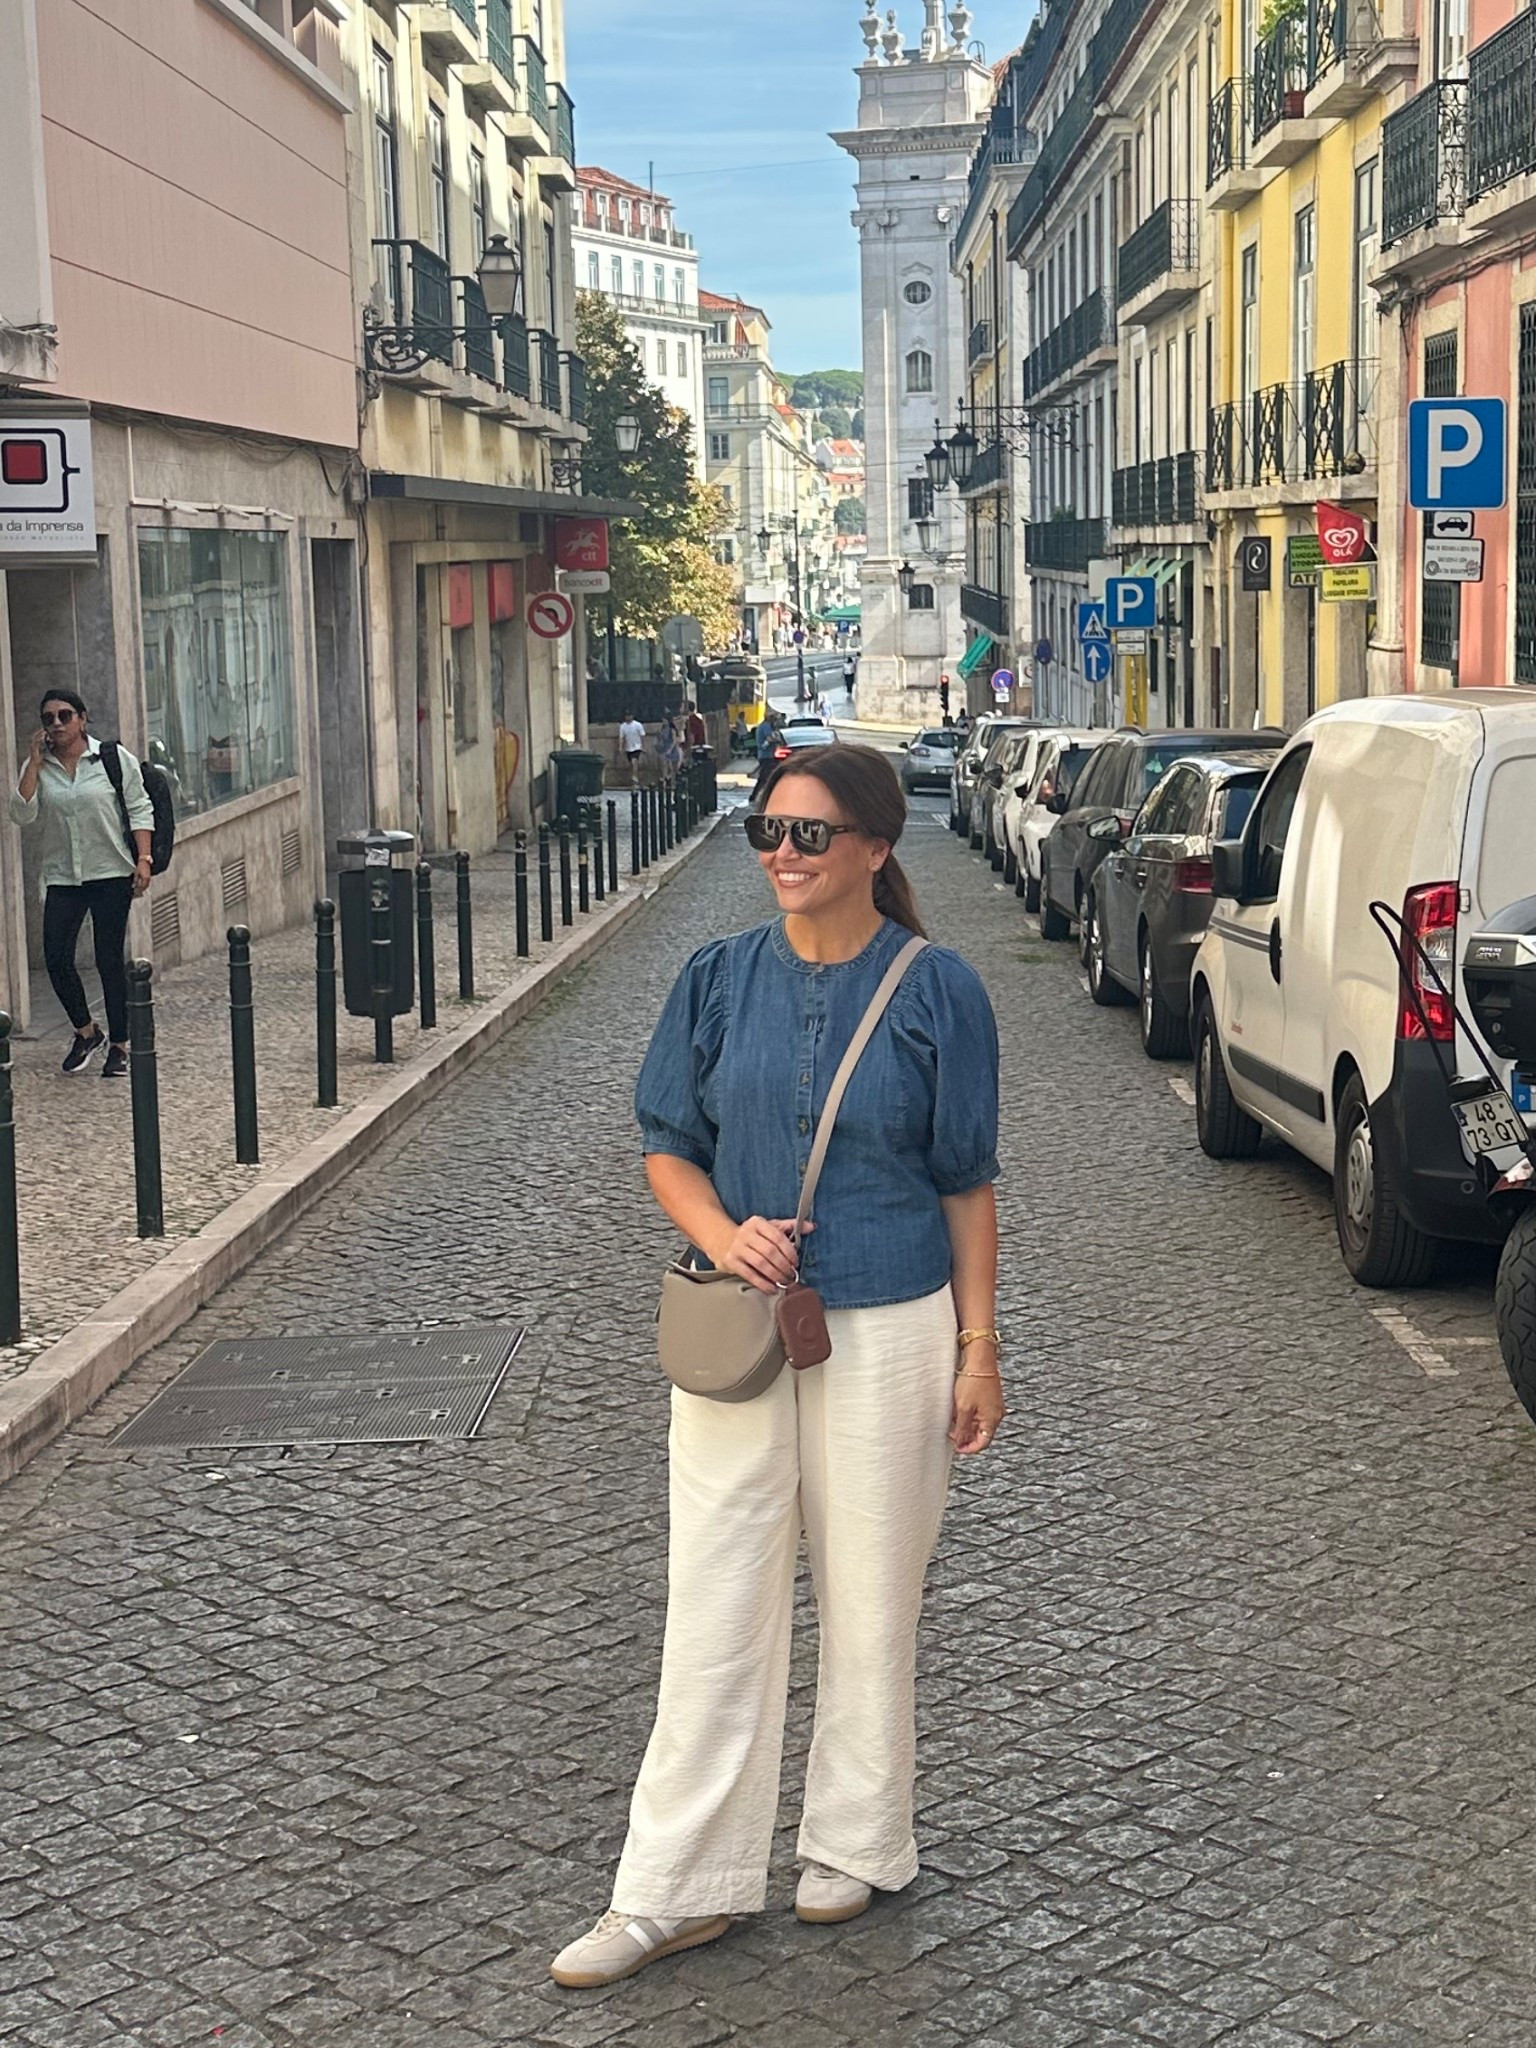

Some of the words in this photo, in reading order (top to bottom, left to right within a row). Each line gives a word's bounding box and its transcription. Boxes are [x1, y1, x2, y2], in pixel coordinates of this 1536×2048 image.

[1427, 408, 1483, 499] P
[7, 520, 22, 531] da
[25, 520, 84, 534] Imprensa
[581, 551, 597, 561] ctt
[1117, 583, 1144, 623] P
[840, 619, 847, 630] P
[1518, 1094, 1526, 1103] P
[1474, 1102, 1496, 1123] 48
